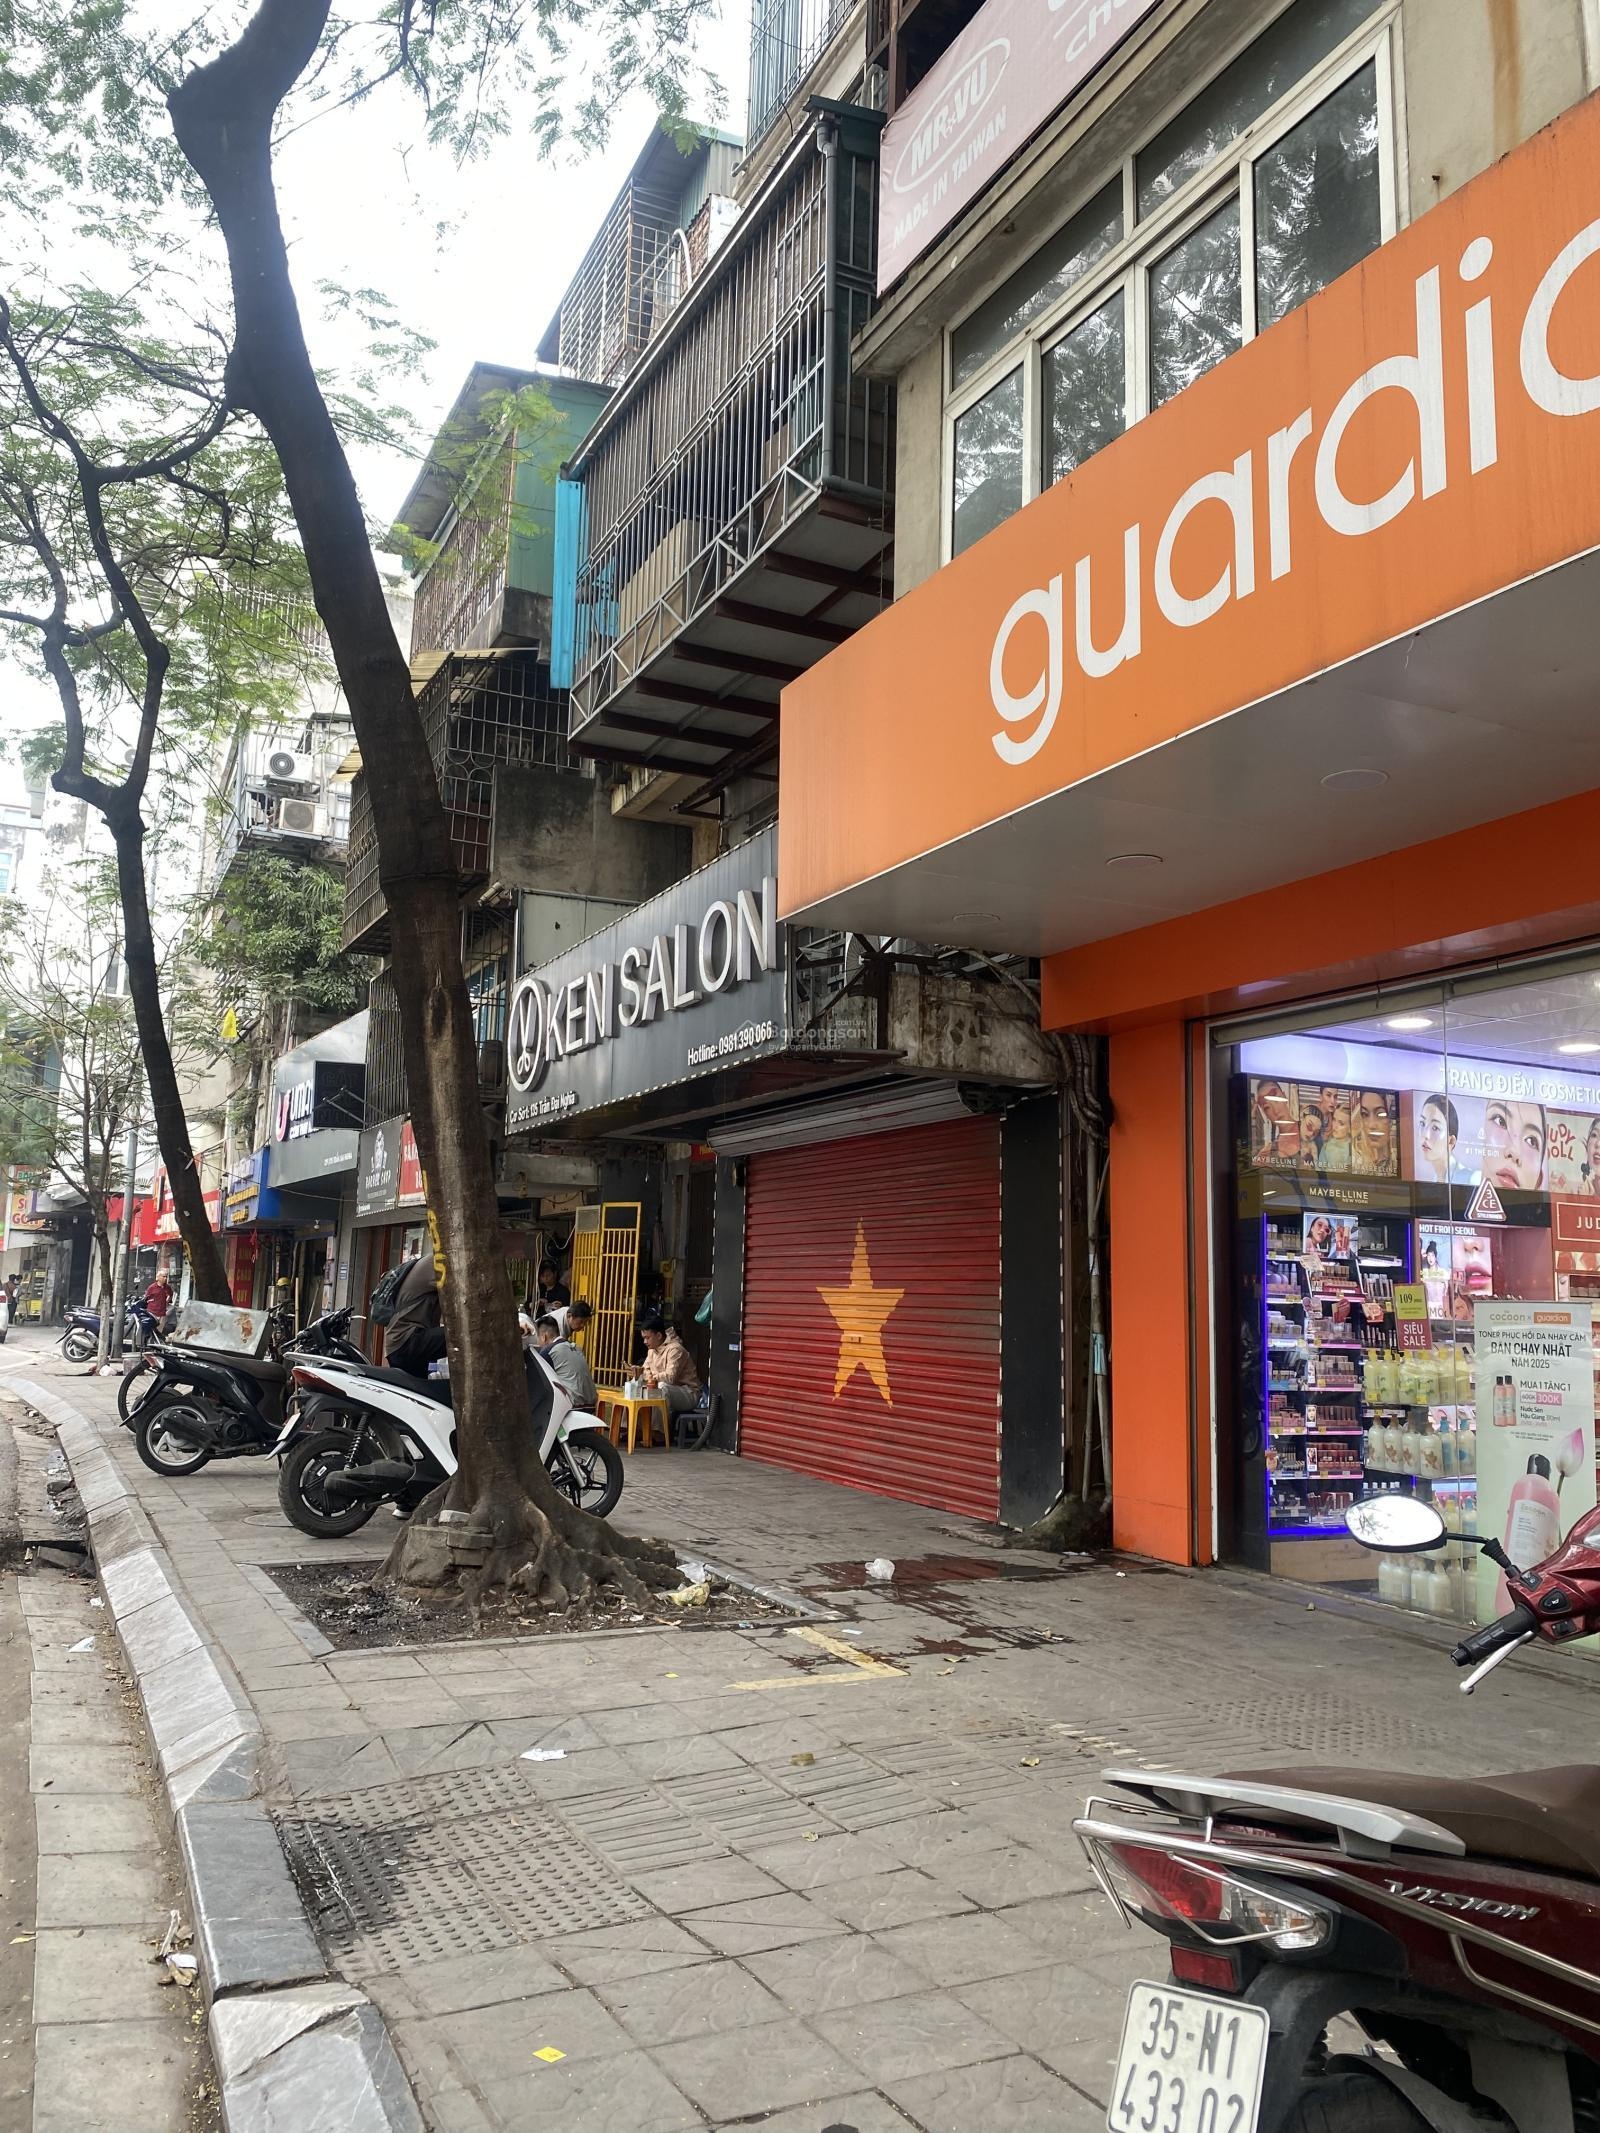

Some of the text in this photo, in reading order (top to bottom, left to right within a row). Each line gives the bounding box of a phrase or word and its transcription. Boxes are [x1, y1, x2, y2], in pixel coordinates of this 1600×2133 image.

[894, 105, 1007, 246] MADE IN TAIWAN
[546, 876, 777, 1061] KEN SALON
[687, 1043, 719, 1066] Hotline:
[1440, 1066, 1494, 1092] TRANG
[1496, 1071, 1535, 1096] ĐIỂM
[1252, 1156, 1297, 1165] MAYBELLINE
[1303, 1160, 1349, 1170] MAYBELLINE
[1309, 1187, 1369, 1199] MAYBELLINE
[1419, 1223, 1433, 1233] HOT
[1454, 1226, 1478, 1236] SEOUL
[1400, 1293, 1413, 1304] 109
[1489, 1312, 1526, 1321] cocoon
[1536, 1314, 1569, 1323] guardian
[1403, 1321, 1424, 1335] SIÊU
[1403, 1335, 1427, 1346] SALE
[1478, 1330, 1500, 1339] TONER
[1536, 1332, 1546, 1340] DA
[1531, 1359, 1550, 1368] 2025
[1520, 1381, 1538, 1389] MUA
[1537, 1393, 1560, 1404] 300K
[1383, 1878, 1541, 1921] VISION
[1141, 1996, 1242, 2080] 35-N1
